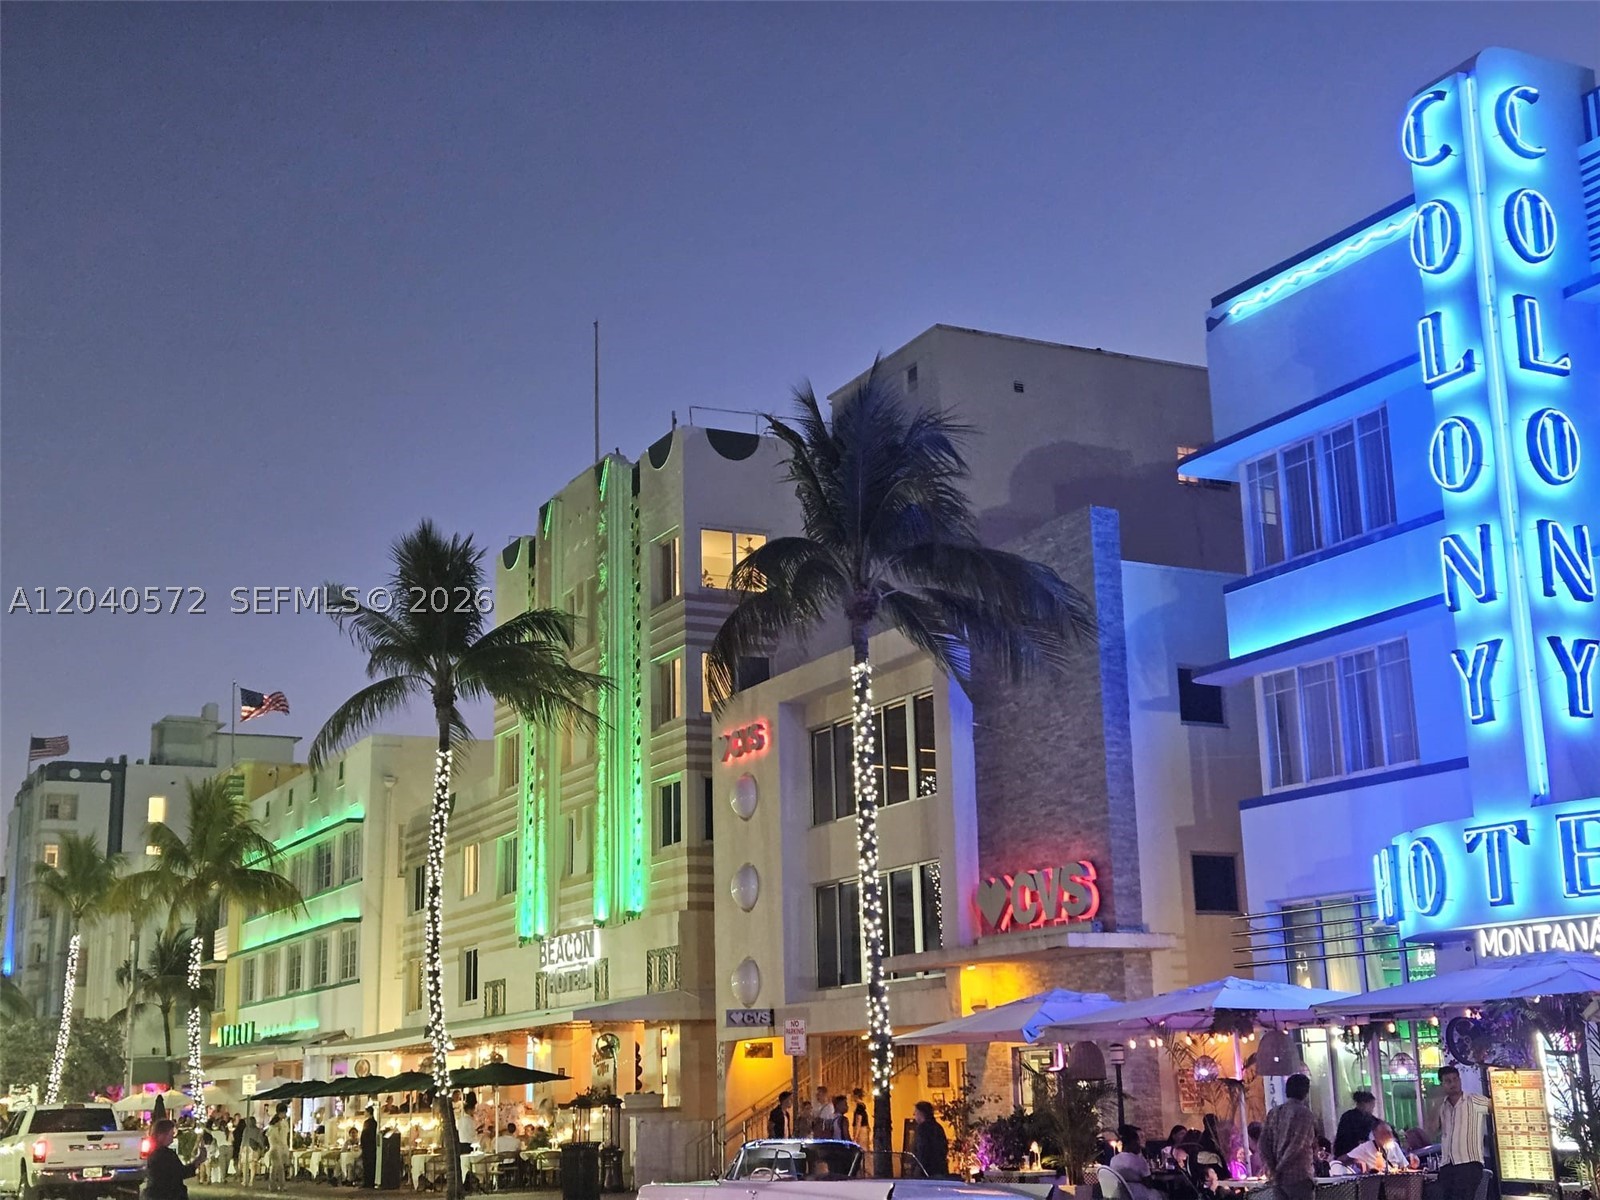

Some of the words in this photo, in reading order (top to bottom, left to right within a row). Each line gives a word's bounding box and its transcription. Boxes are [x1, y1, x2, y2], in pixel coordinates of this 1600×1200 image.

[1402, 90, 1504, 725] COLONY
[1495, 86, 1600, 719] COLONY
[731, 723, 768, 758] CVS
[1011, 861, 1098, 925] CVS
[539, 929, 595, 968] BEACON
[547, 968, 592, 994] HOTEL
[743, 1011, 771, 1025] CVS
[790, 1020, 800, 1028] NO
